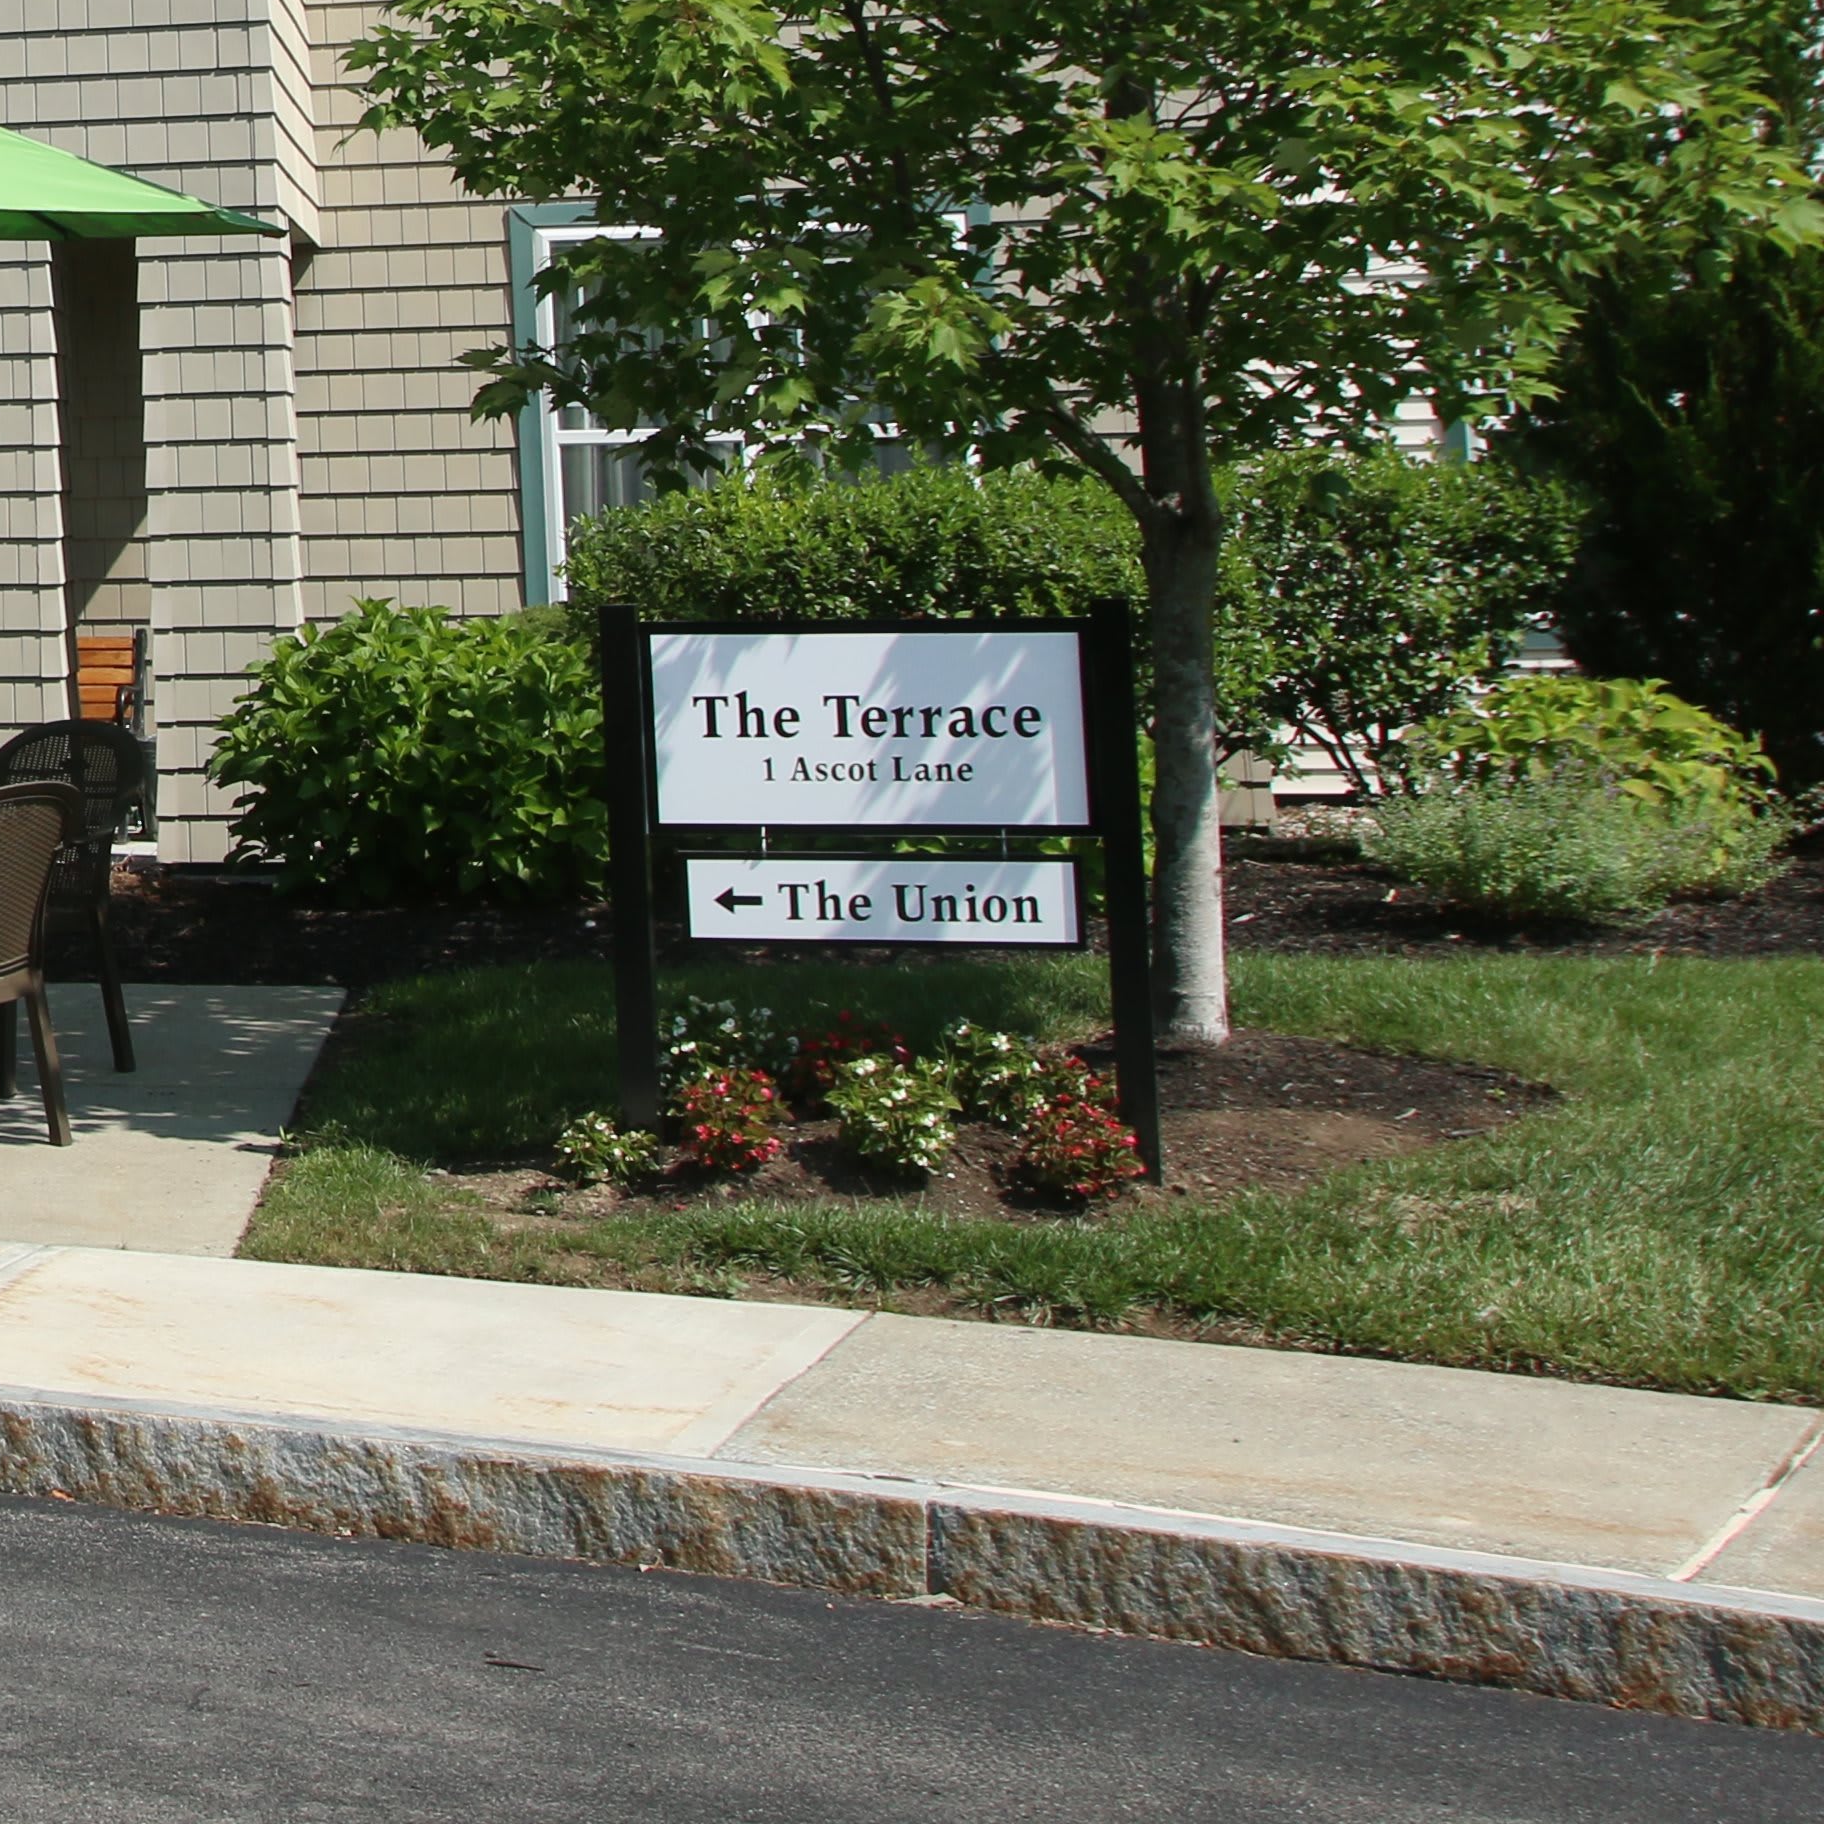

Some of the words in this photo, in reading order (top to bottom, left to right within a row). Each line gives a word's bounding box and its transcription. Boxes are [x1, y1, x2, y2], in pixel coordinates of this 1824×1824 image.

[691, 689, 801, 740] The
[822, 694, 1043, 740] Terrace
[763, 755, 775, 782] 1
[790, 755, 879, 783] Ascot
[890, 755, 975, 784] Lane
[776, 878, 874, 923] The
[889, 882, 1044, 925] Union
